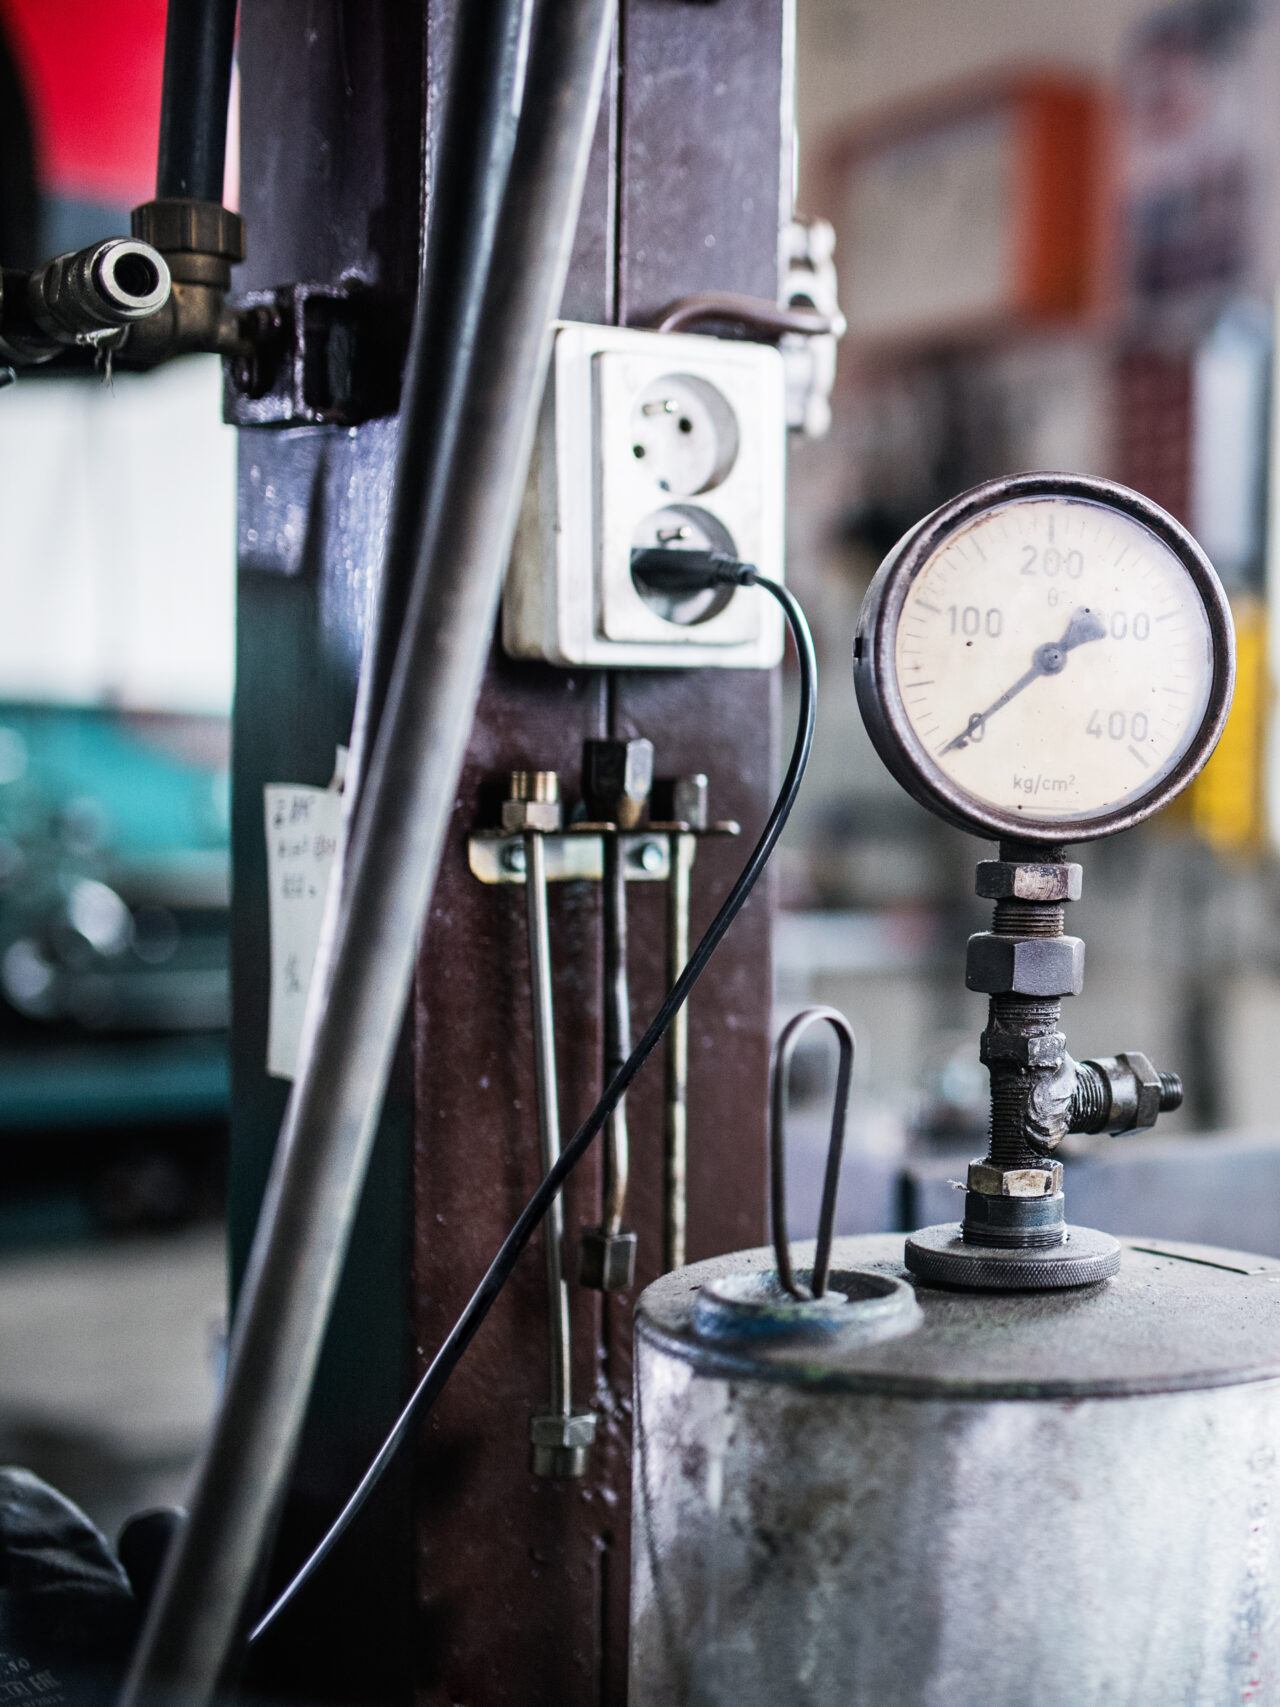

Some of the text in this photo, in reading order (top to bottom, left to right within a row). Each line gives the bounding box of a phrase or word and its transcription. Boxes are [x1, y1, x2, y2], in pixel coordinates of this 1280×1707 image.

[1020, 545, 1085, 579] 200
[946, 604, 1004, 638] 100
[1103, 611, 1150, 642] 00
[966, 711, 987, 743] 0
[1086, 711, 1149, 743] 400
